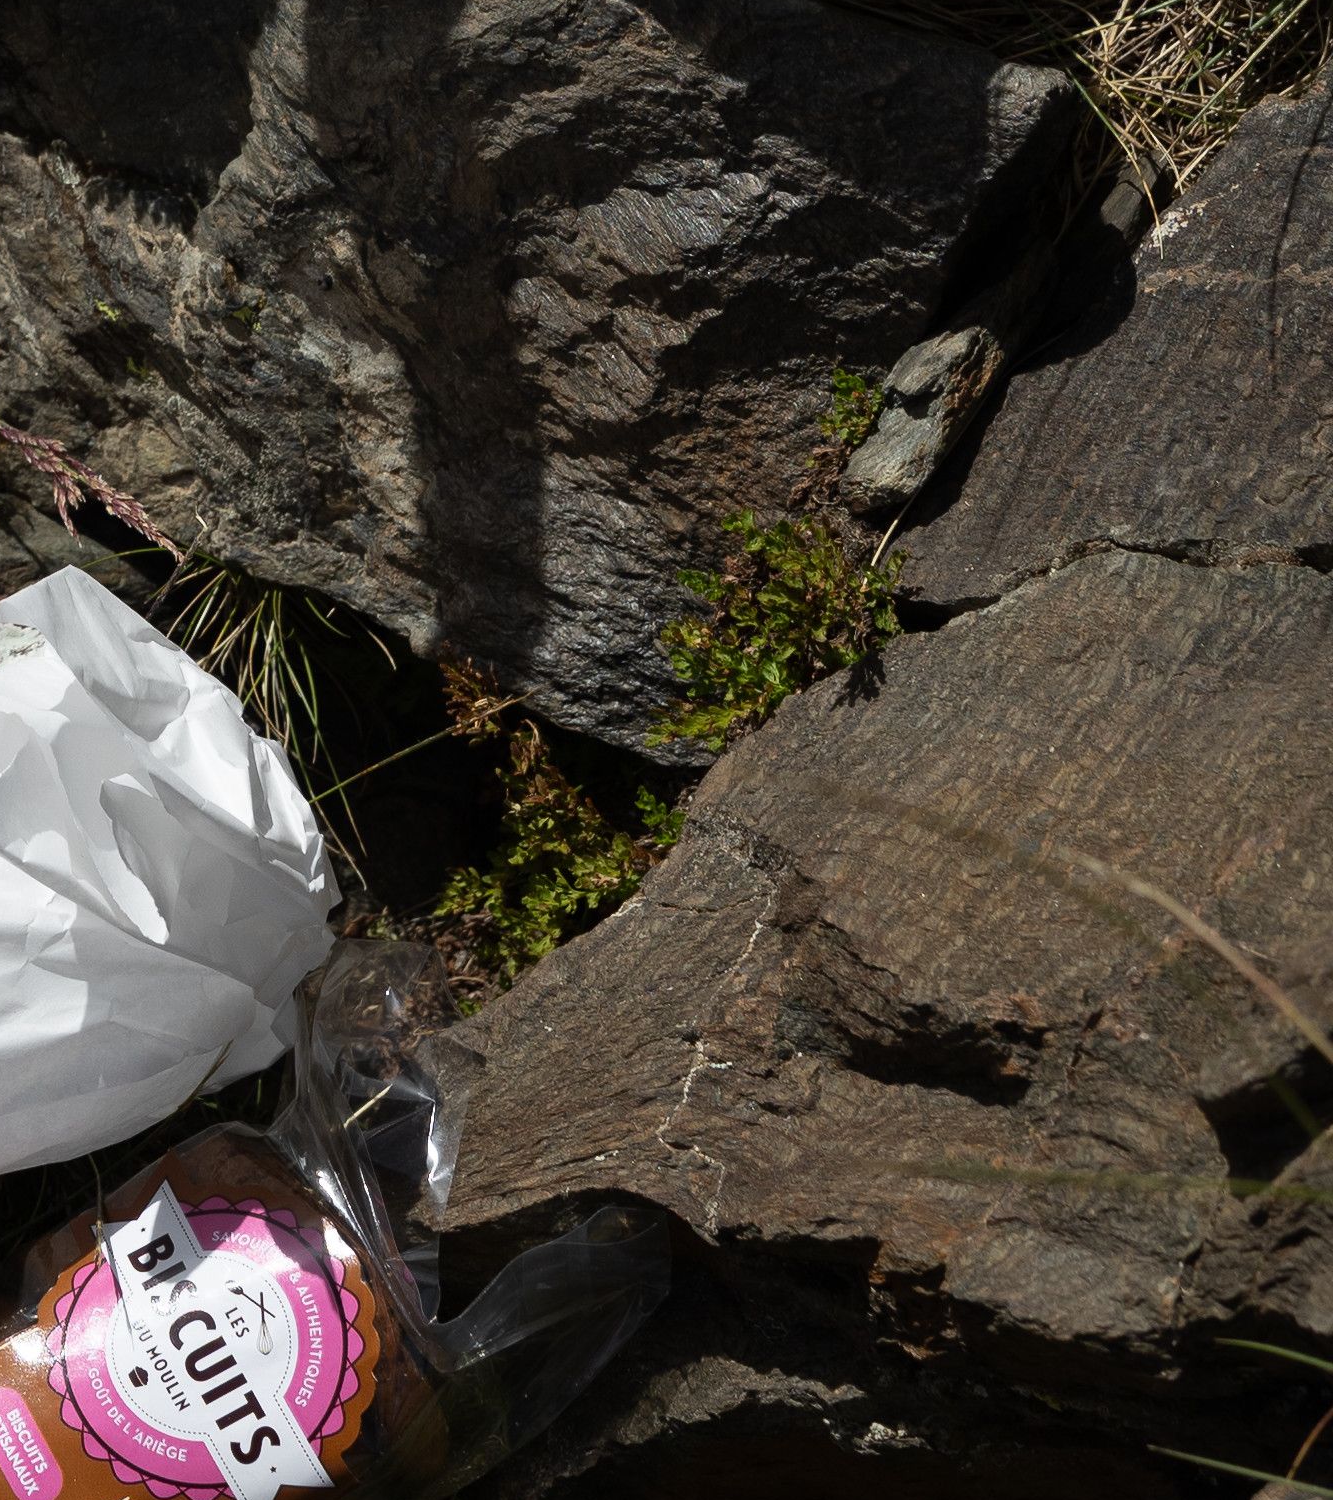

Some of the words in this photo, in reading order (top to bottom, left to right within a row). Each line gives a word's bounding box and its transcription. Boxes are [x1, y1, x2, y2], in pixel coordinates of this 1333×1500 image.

[128, 1233, 280, 1466] BISCUITS
[226, 1307, 250, 1338] LES
[289, 1271, 300, 1285] &
[296, 1286, 324, 1407] AUTHENTIQUES
[88, 1368, 111, 1403] GOÛT
[107, 1403, 124, 1422] DE
[146, 1347, 191, 1413] MOULIN
[6, 1408, 48, 1474] BISCUITS
